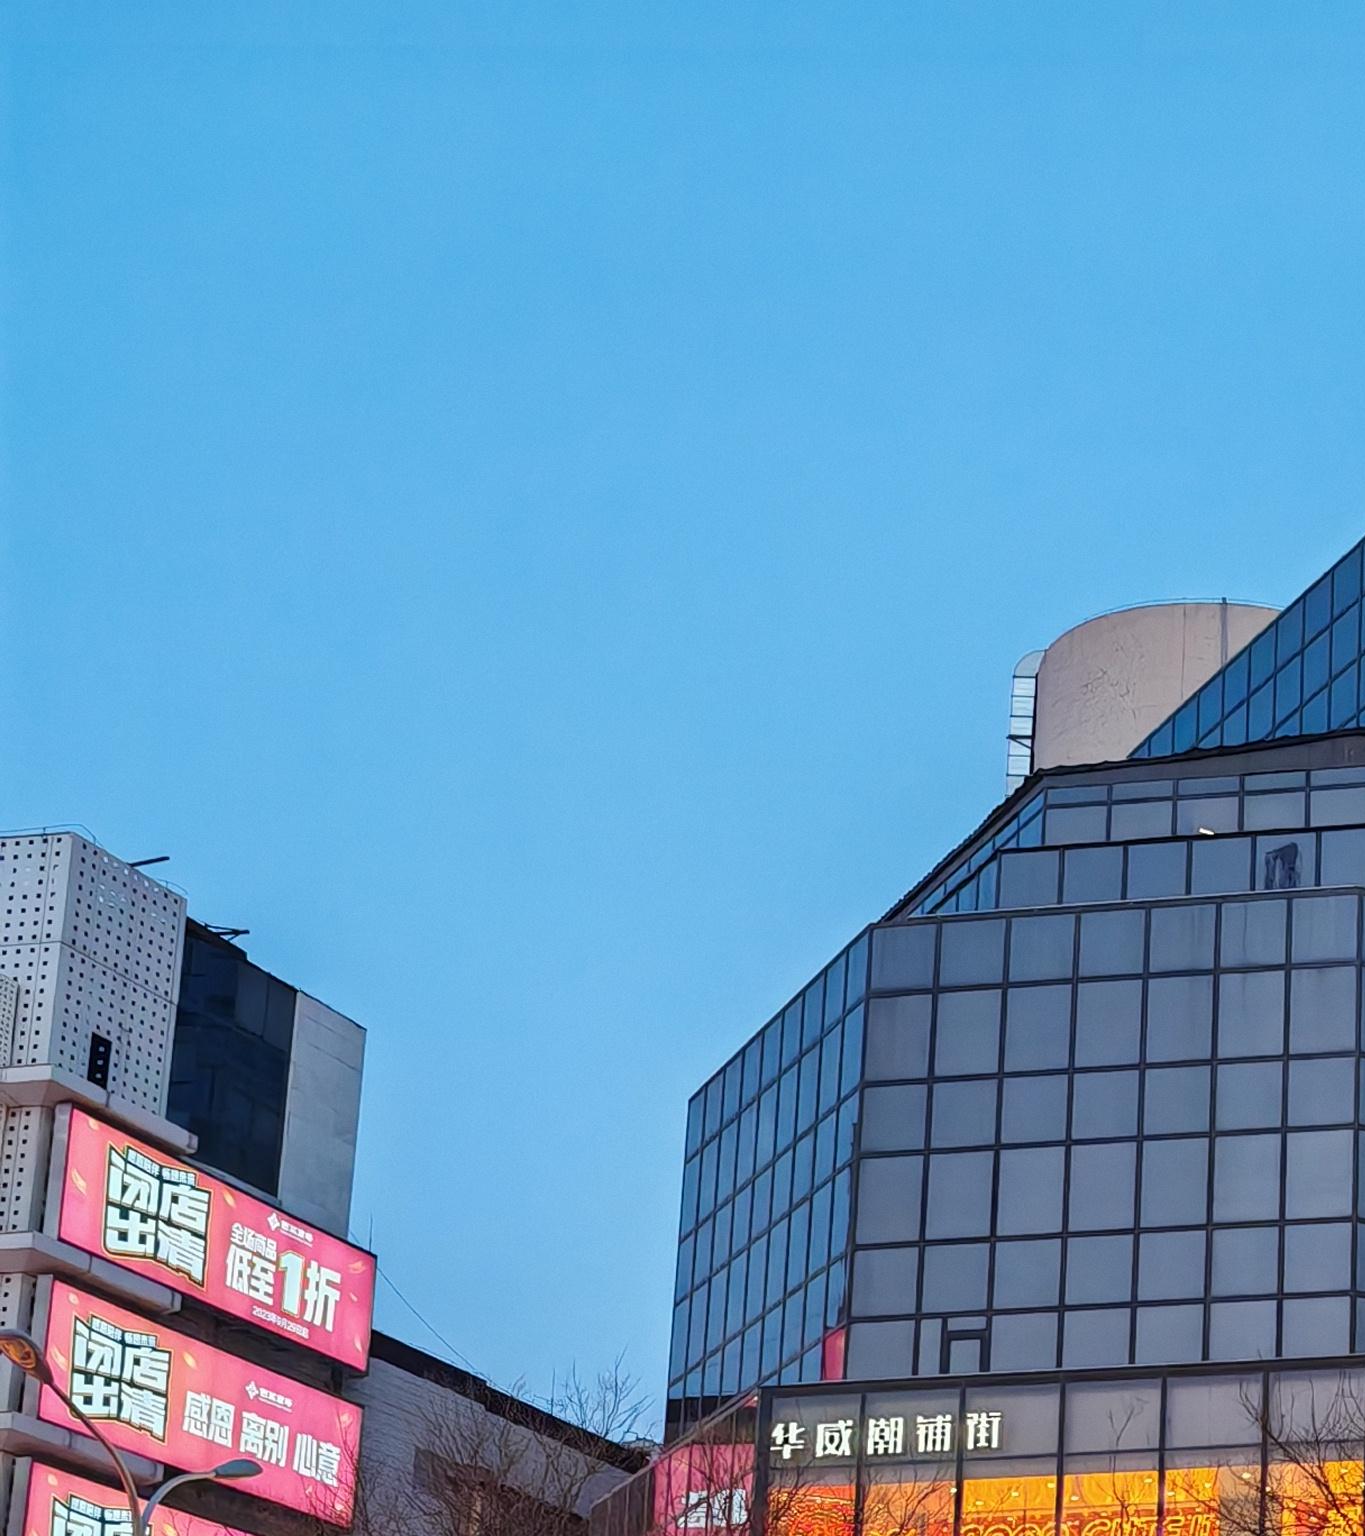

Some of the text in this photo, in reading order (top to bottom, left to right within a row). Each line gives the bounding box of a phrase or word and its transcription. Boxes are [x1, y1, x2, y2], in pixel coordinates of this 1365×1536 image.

[183, 1391, 236, 1448] 感恩
[769, 1412, 1002, 1460] 华威潮铺街
